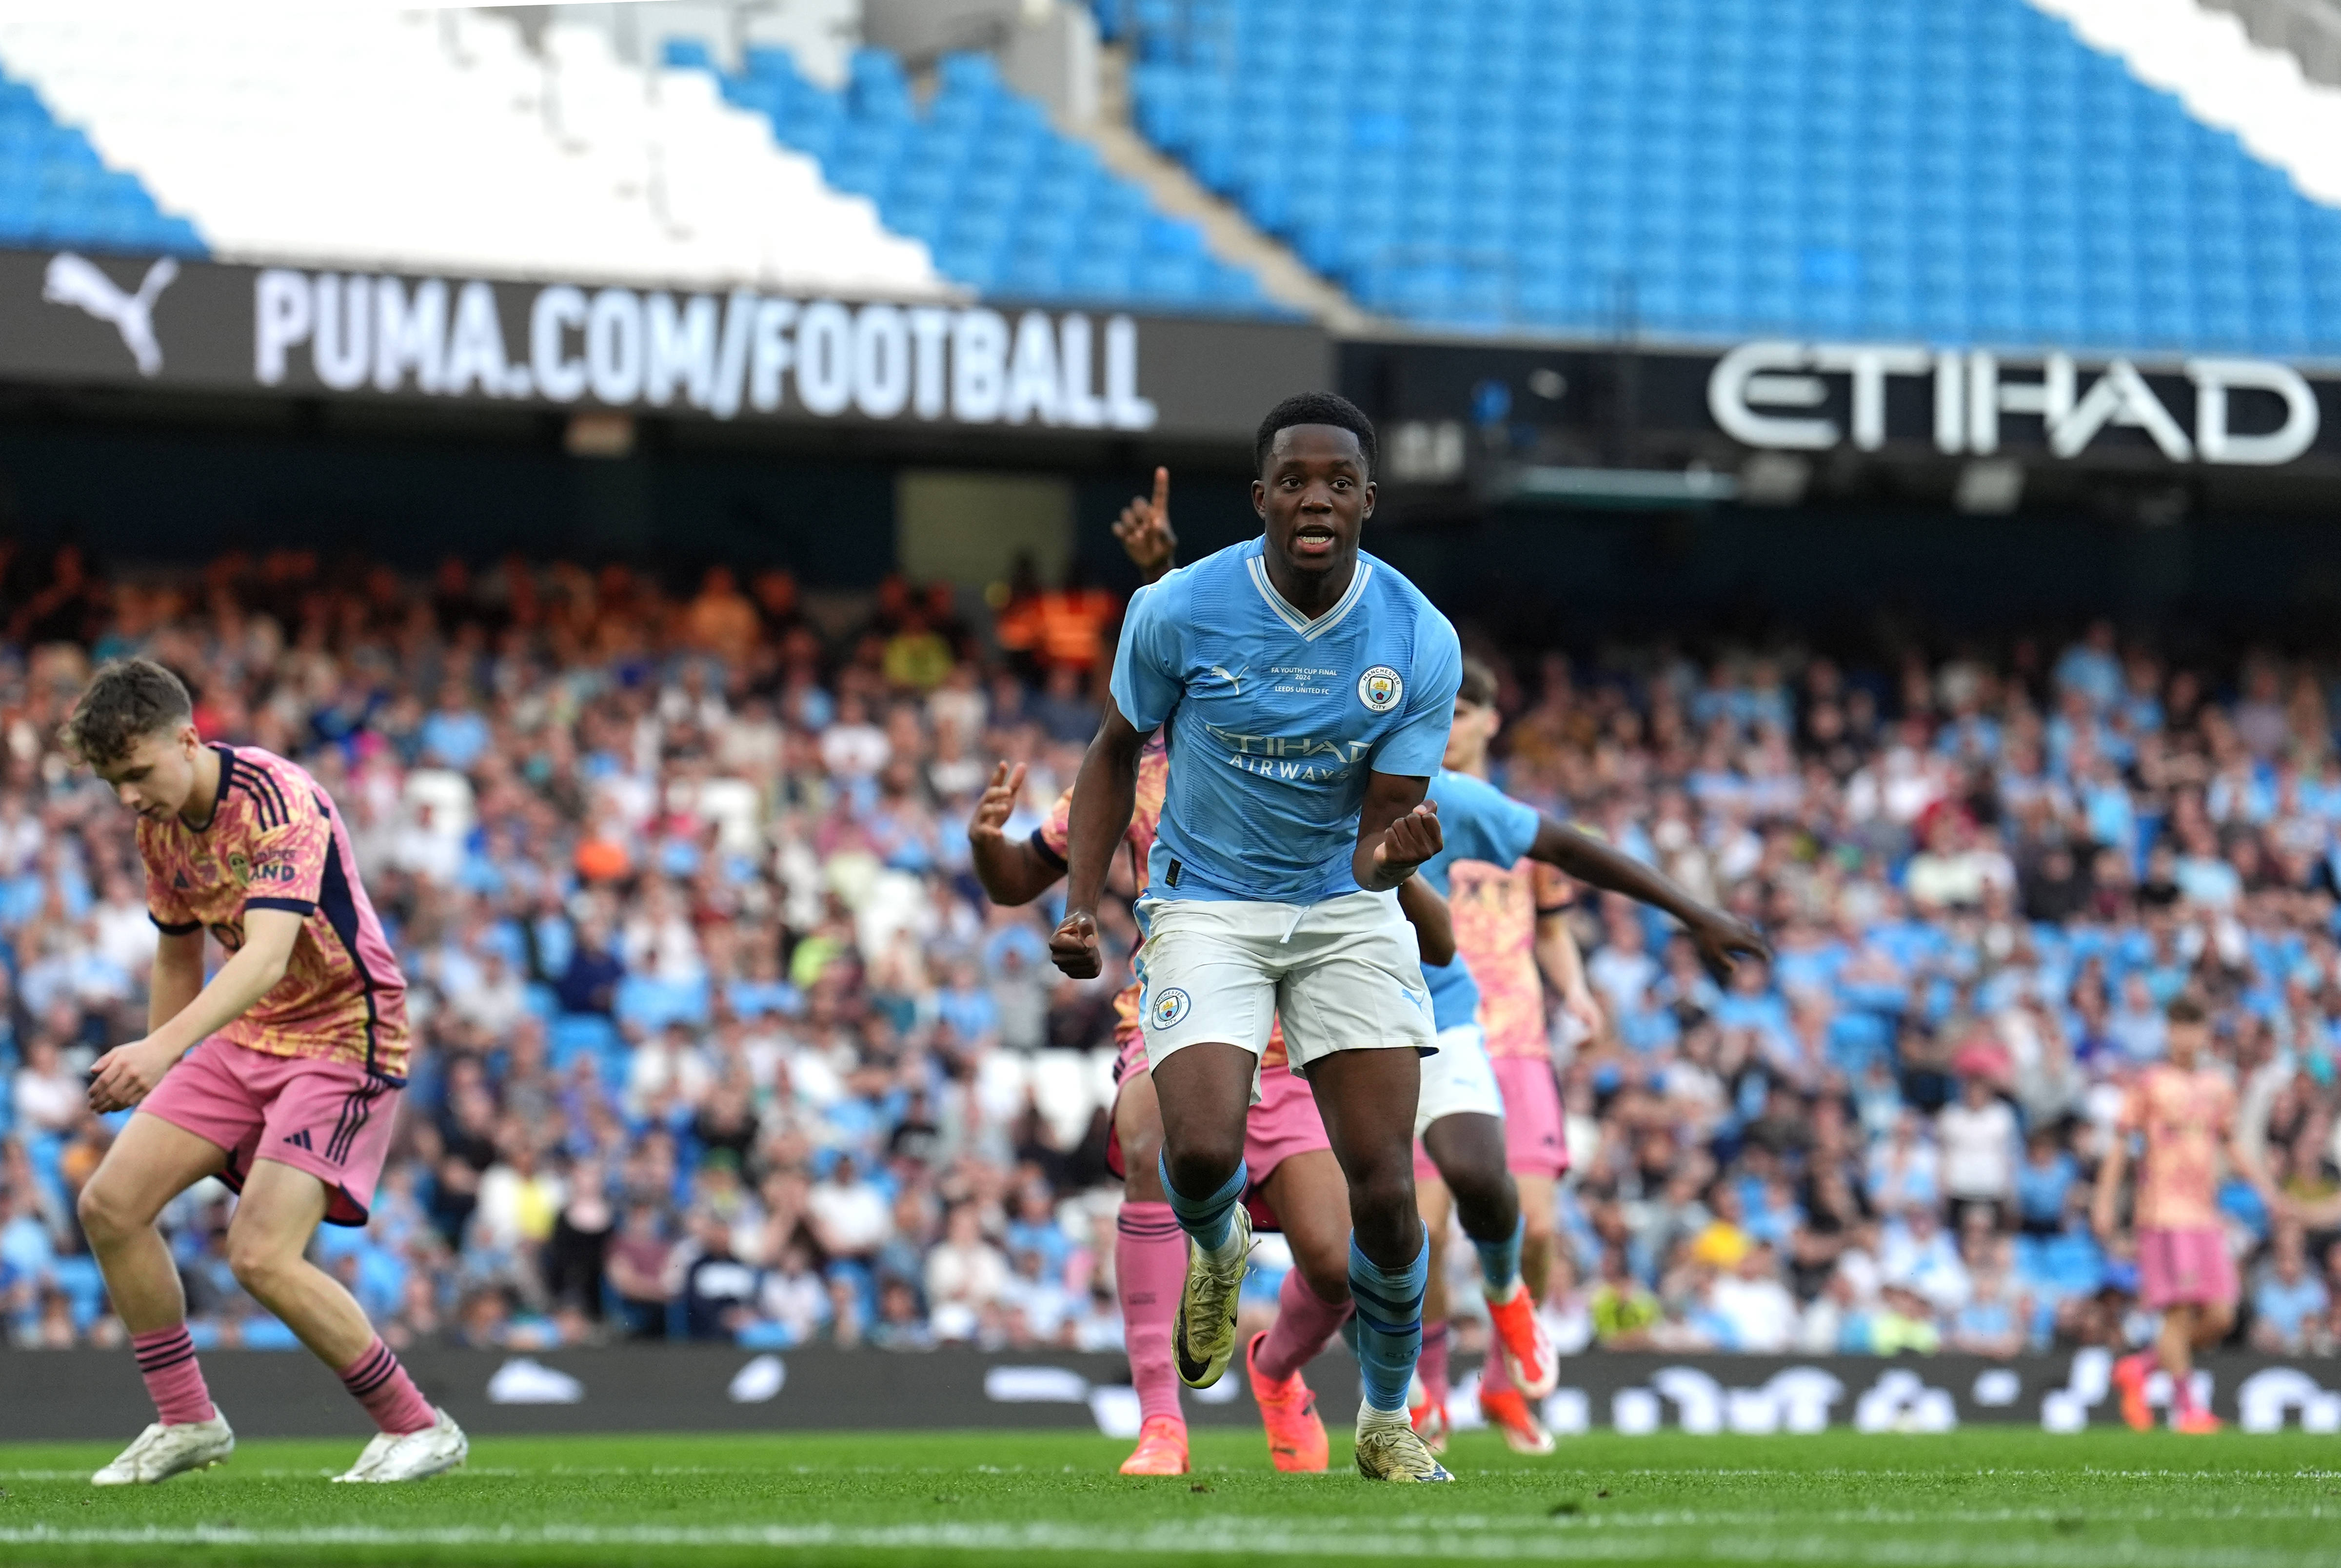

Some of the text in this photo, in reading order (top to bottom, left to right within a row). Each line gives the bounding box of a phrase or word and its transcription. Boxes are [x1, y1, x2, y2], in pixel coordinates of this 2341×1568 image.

[255, 268, 1159, 430] PUMA.COM/FOOTBALL
[1707, 341, 2321, 466] ETIHAD
[1363, 669, 1400, 685] MANCHESTER
[1230, 755, 1349, 780] AIRWAYS
